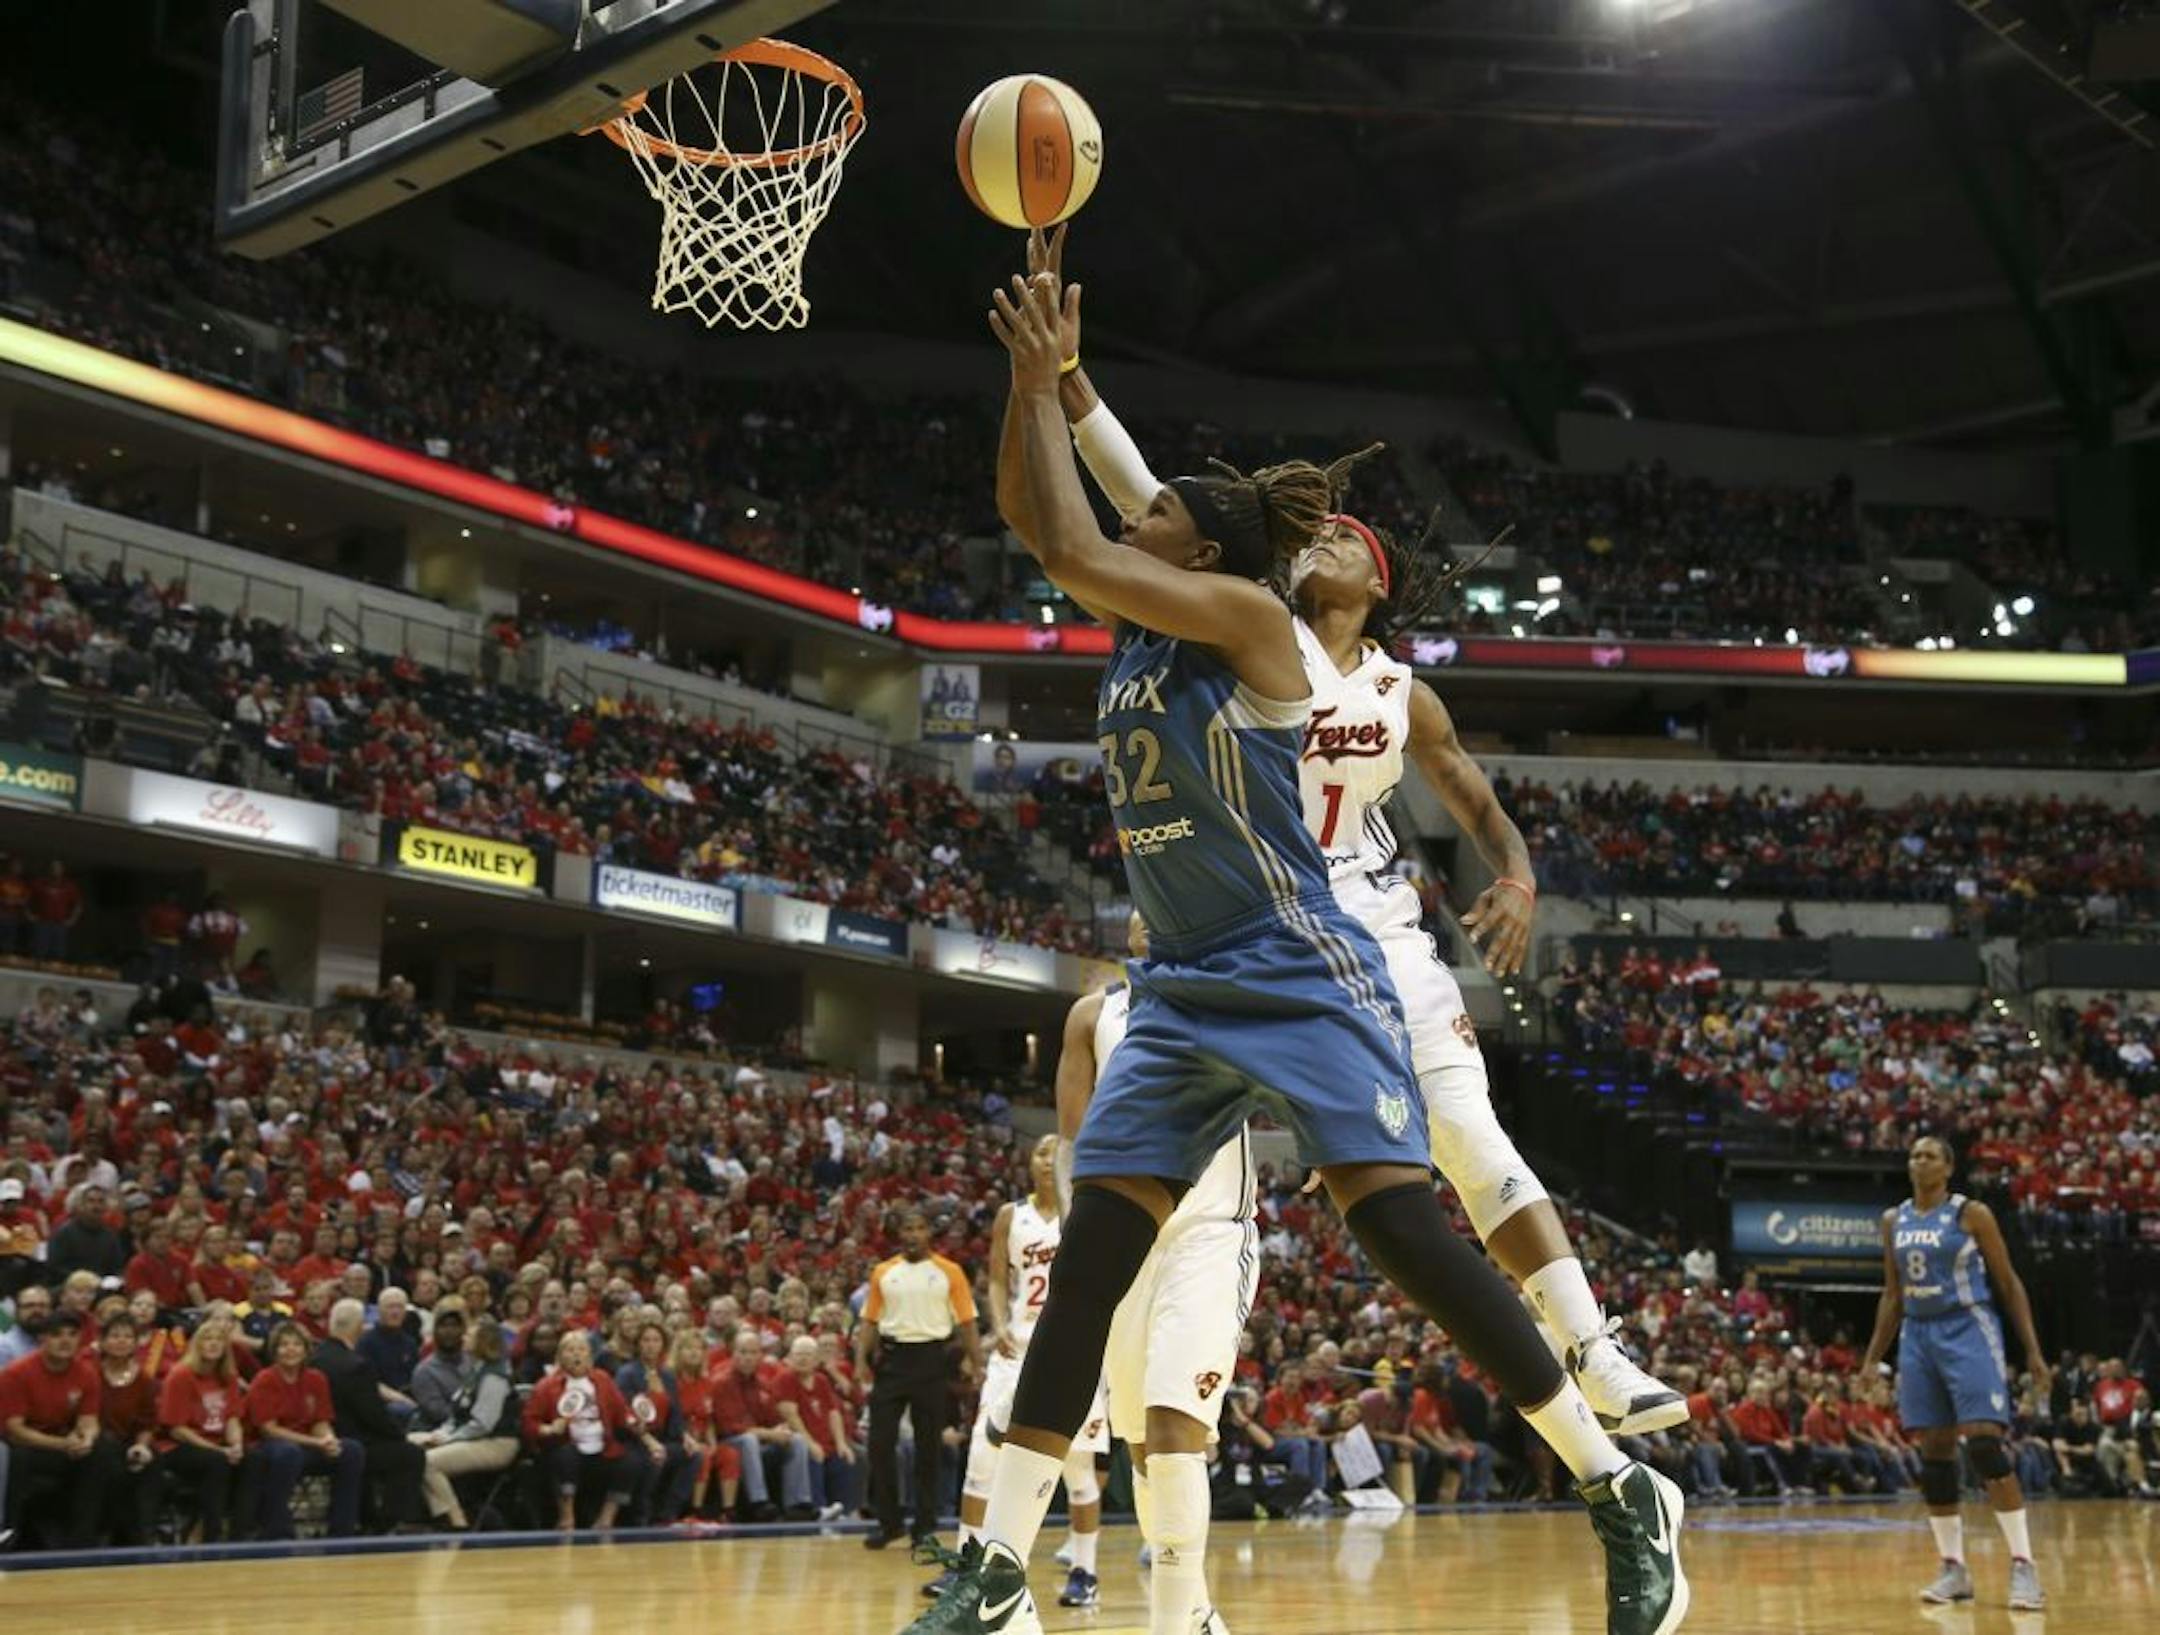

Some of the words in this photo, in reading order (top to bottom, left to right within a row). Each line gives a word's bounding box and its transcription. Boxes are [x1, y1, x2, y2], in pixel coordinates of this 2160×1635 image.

[1304, 704, 1390, 757] Fever
[1099, 727, 1173, 808] 32
[200, 790, 274, 832] Lilly
[1319, 785, 1344, 848] 1
[412, 836, 527, 878] STANLEY
[602, 871, 733, 915] ticketmaster
[1799, 1215, 1876, 1232] citizens
[1906, 1250, 1927, 1281] 8
[1027, 1275, 1047, 1306] 2
